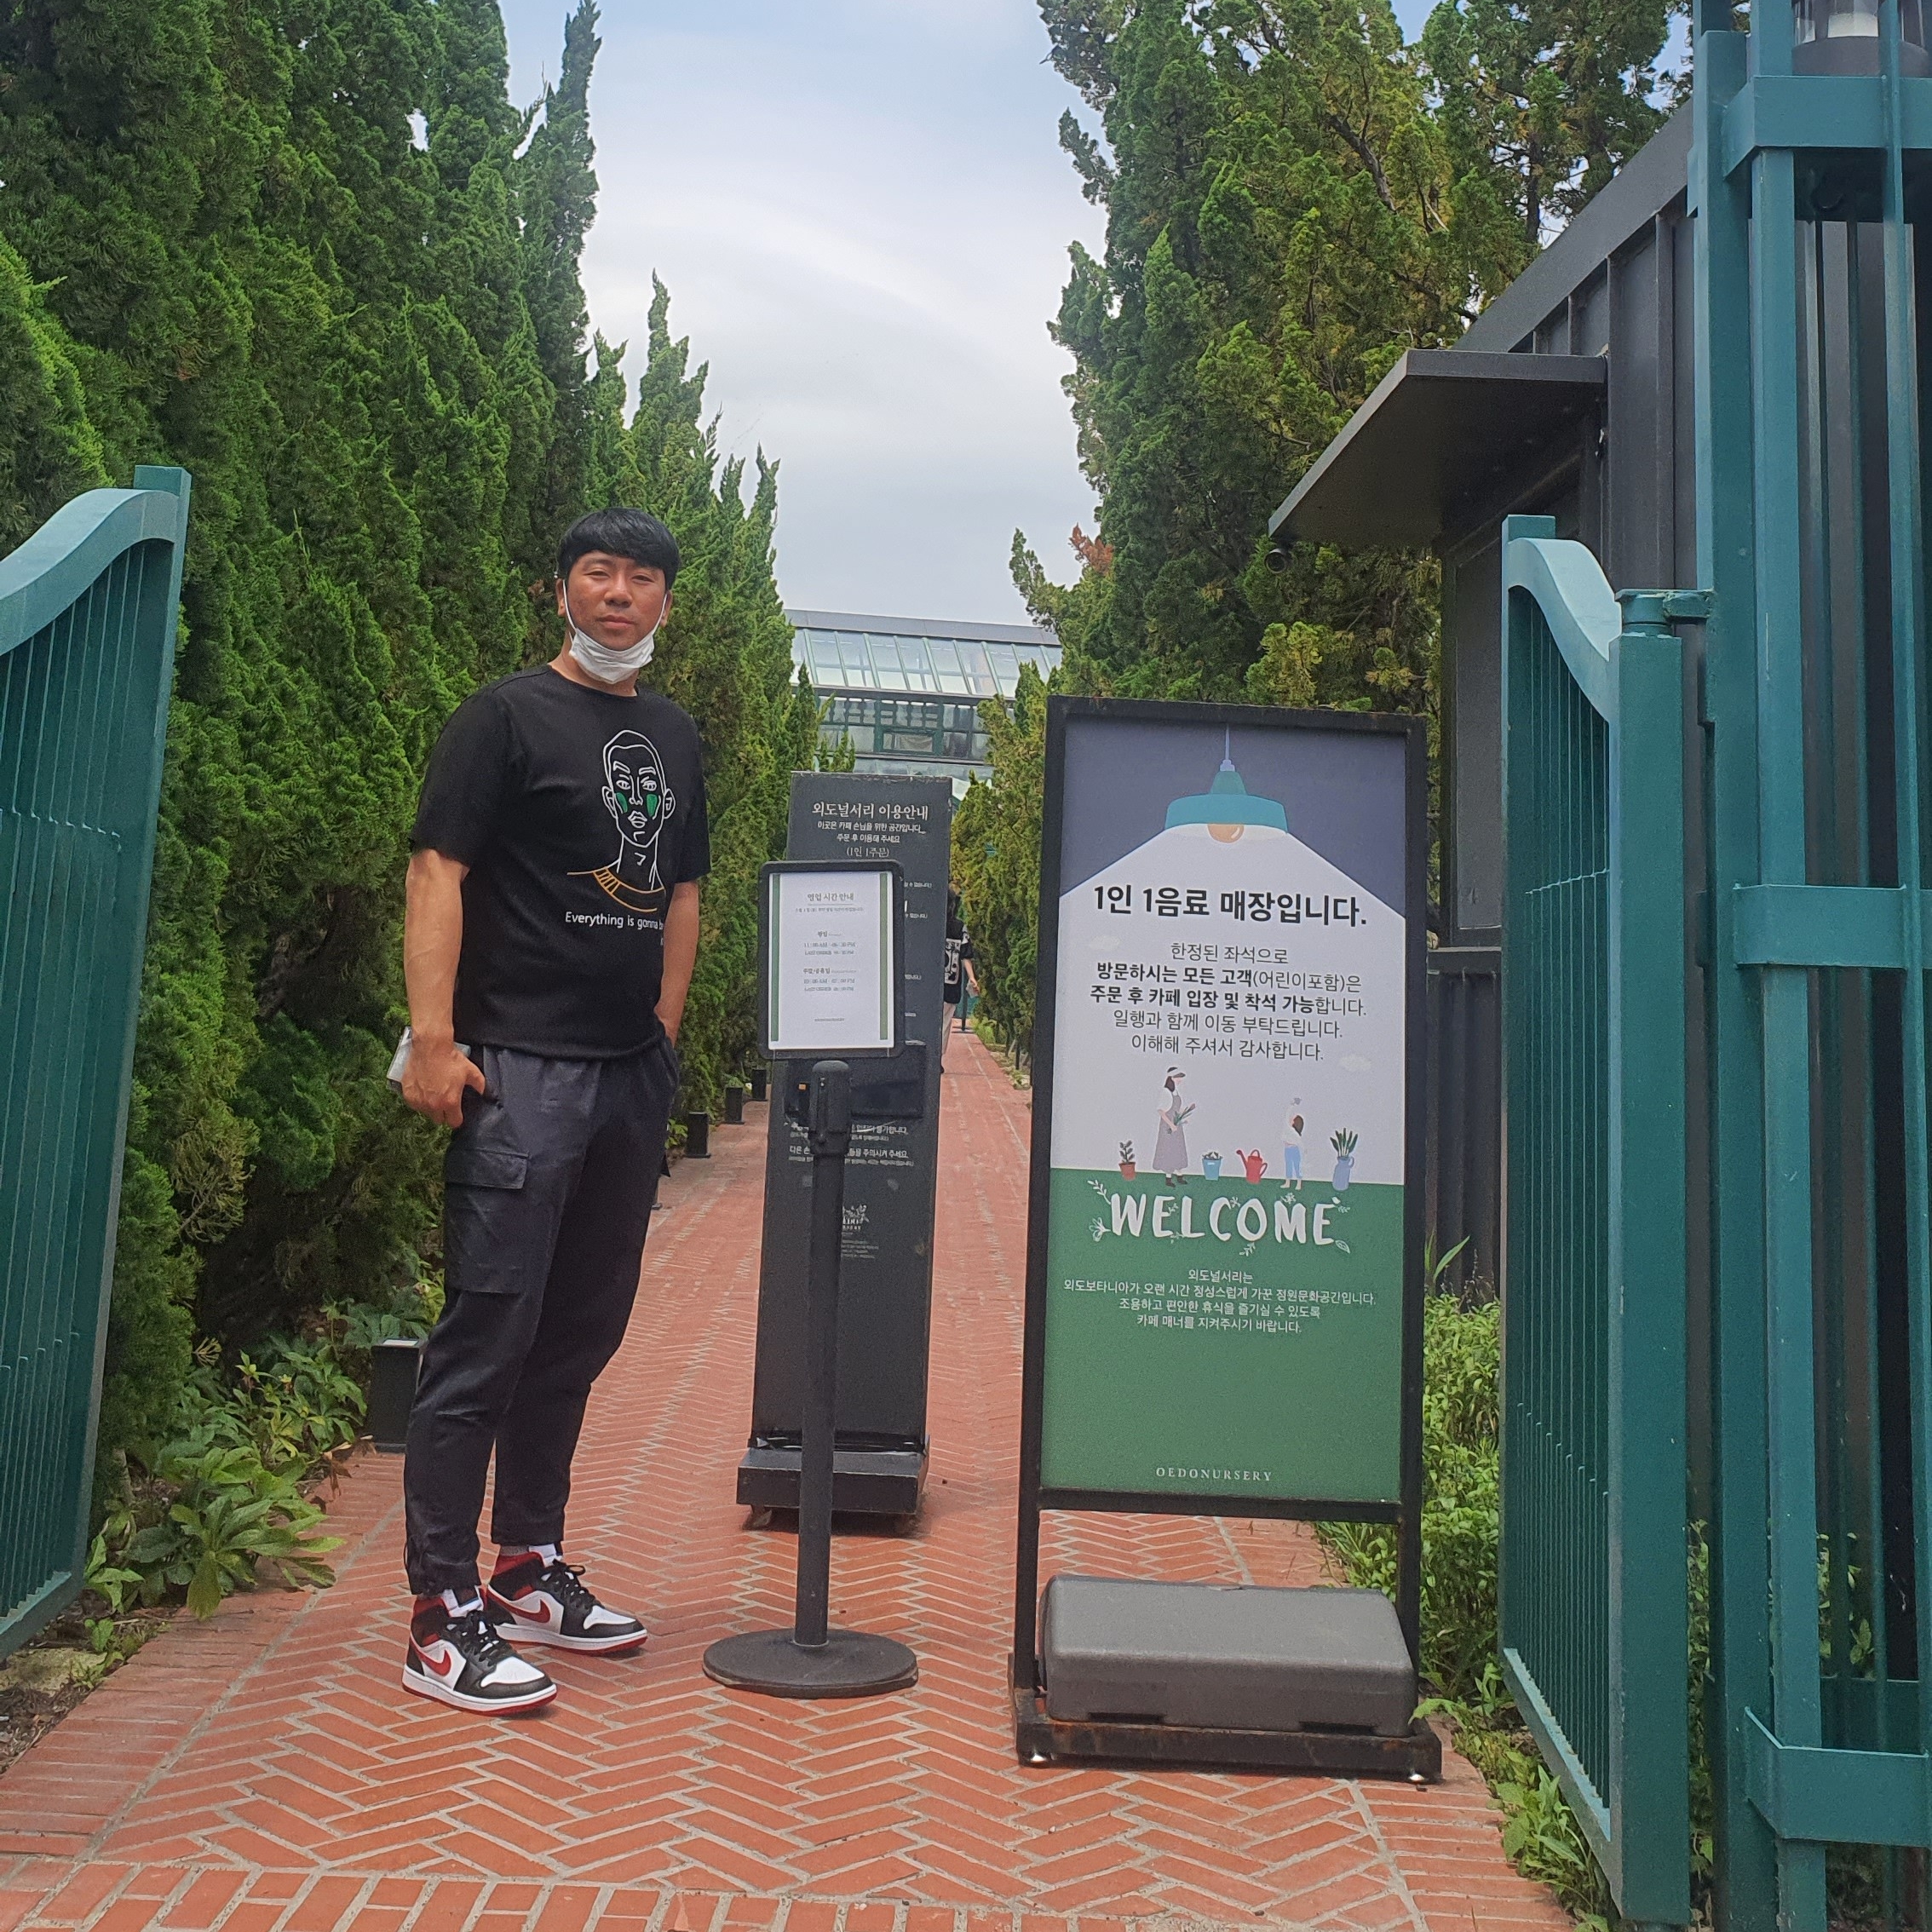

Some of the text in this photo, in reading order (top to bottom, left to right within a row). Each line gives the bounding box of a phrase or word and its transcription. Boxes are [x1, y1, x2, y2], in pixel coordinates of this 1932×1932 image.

[812, 802, 929, 820] 외도널서리 이용안내
[1094, 884, 1366, 928] 1인 1음료 매장입니다.
[565, 911, 624, 929] Everything
[627, 915, 635, 927] is
[637, 918, 658, 930] gonna
[1170, 942, 1289, 963] 한정된 좌석으로
[1097, 962, 1362, 993] 방문하시는 모든 고객(어린이포함)은
[1090, 985, 1367, 1016] 주문 후 카페 입장 및 착석 가능합니다.
[1113, 1009, 1343, 1039] 일행과 함께 이동 부탁드립니다.
[1131, 1033, 1324, 1061] 이해해 주셔서 감사합니다.
[1109, 1193, 1336, 1245] WELCOME
[1188, 1268, 1253, 1285] 외도널서리는
[1064, 1279, 1377, 1305] 외도보타니아가 오랜 시간 정성스럽게 가꾼 정원문화공간입니다.
[1118, 1297, 1321, 1319] 조용하고 편안한 휴식을 즐기실 수 있도록
[1136, 1314, 1302, 1334] 카페 매너를 지켜주시기 바랍니다.
[1155, 1467, 1272, 1481] OEDONURSERY
